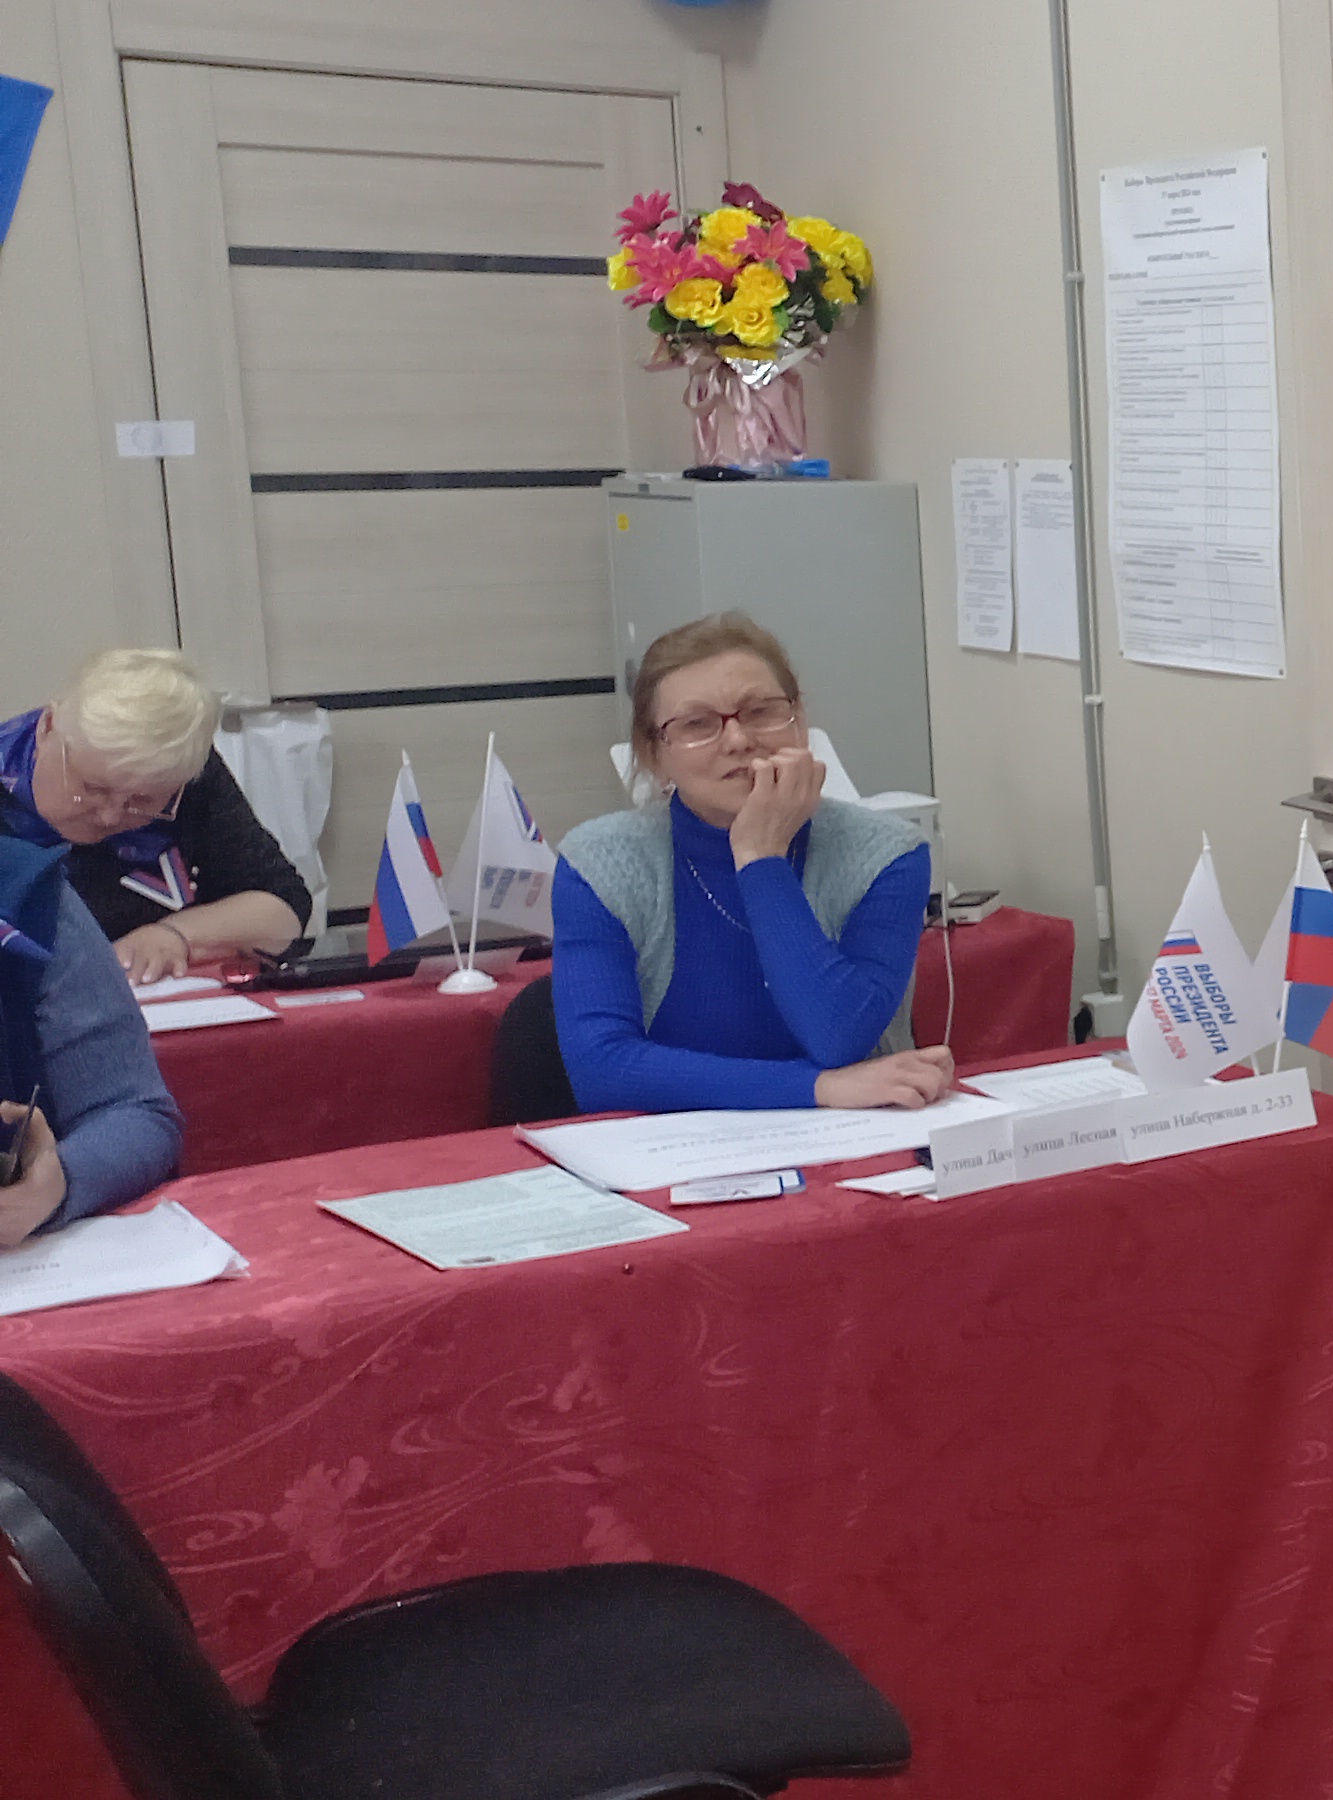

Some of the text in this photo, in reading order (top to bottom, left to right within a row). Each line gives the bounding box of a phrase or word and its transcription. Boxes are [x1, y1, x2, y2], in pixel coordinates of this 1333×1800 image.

[1154, 966, 1193, 1024] РОССИИ
[1171, 965, 1229, 1055] ПРЕЗИДЕНТА
[1193, 963, 1237, 1025] ВЫБОРЫ
[1022, 1127, 1117, 1159] улица Лесная
[1130, 1119, 1171, 1140] улица
[1265, 1094, 1294, 1112] 2-33
[942, 1148, 1013, 1177] улица Дач
